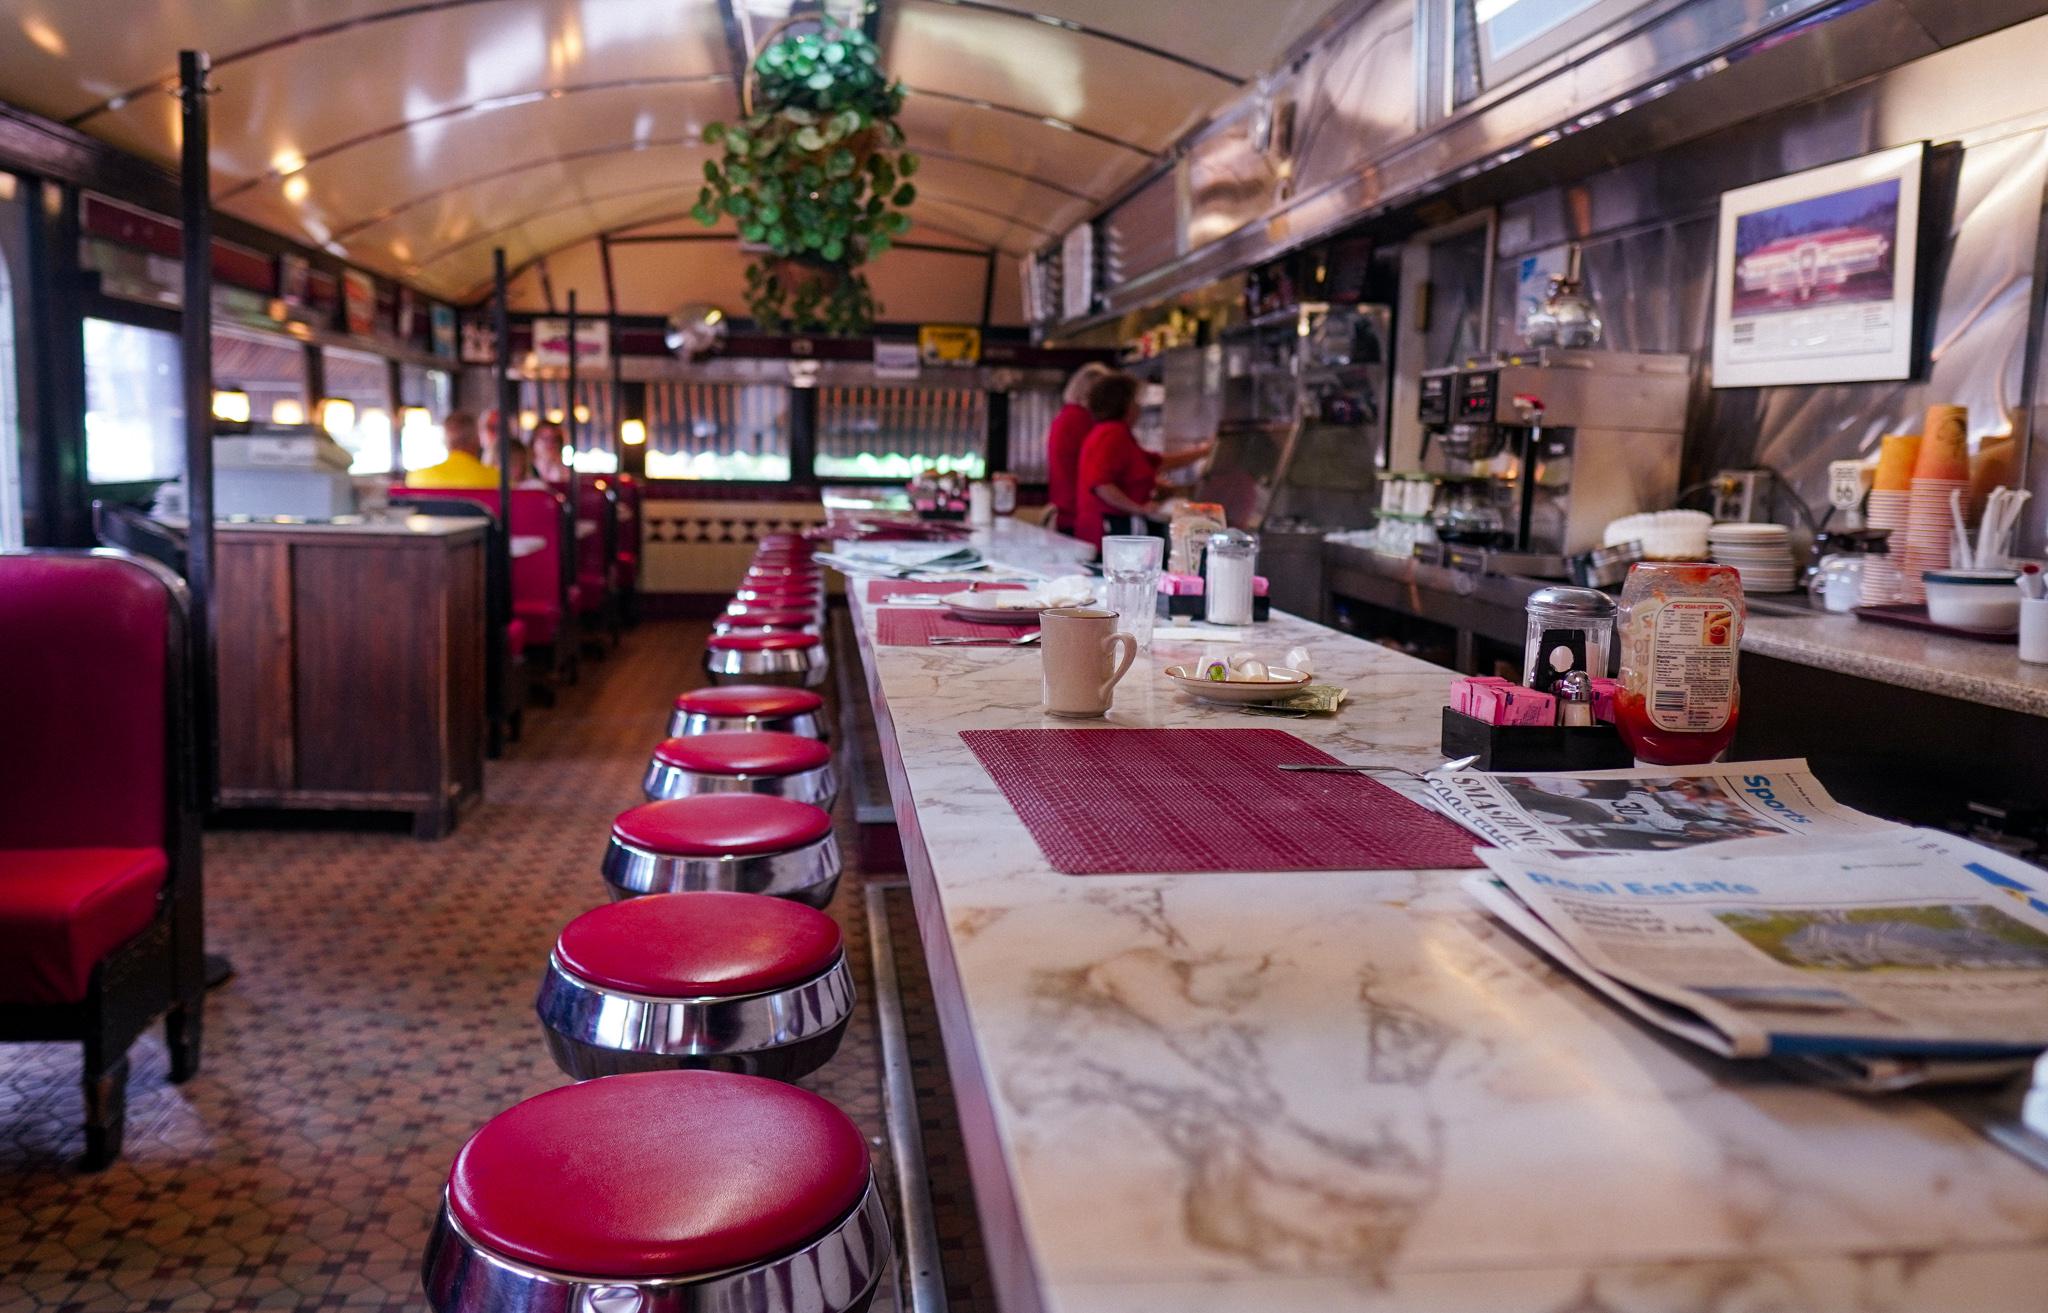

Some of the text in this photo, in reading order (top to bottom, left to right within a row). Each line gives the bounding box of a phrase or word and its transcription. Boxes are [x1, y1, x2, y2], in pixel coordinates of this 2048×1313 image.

[1452, 777, 1555, 845] SMASHING
[1611, 801, 1650, 815] 30
[1744, 774, 1813, 823] Sports
[1526, 871, 1760, 896] Real Estate
